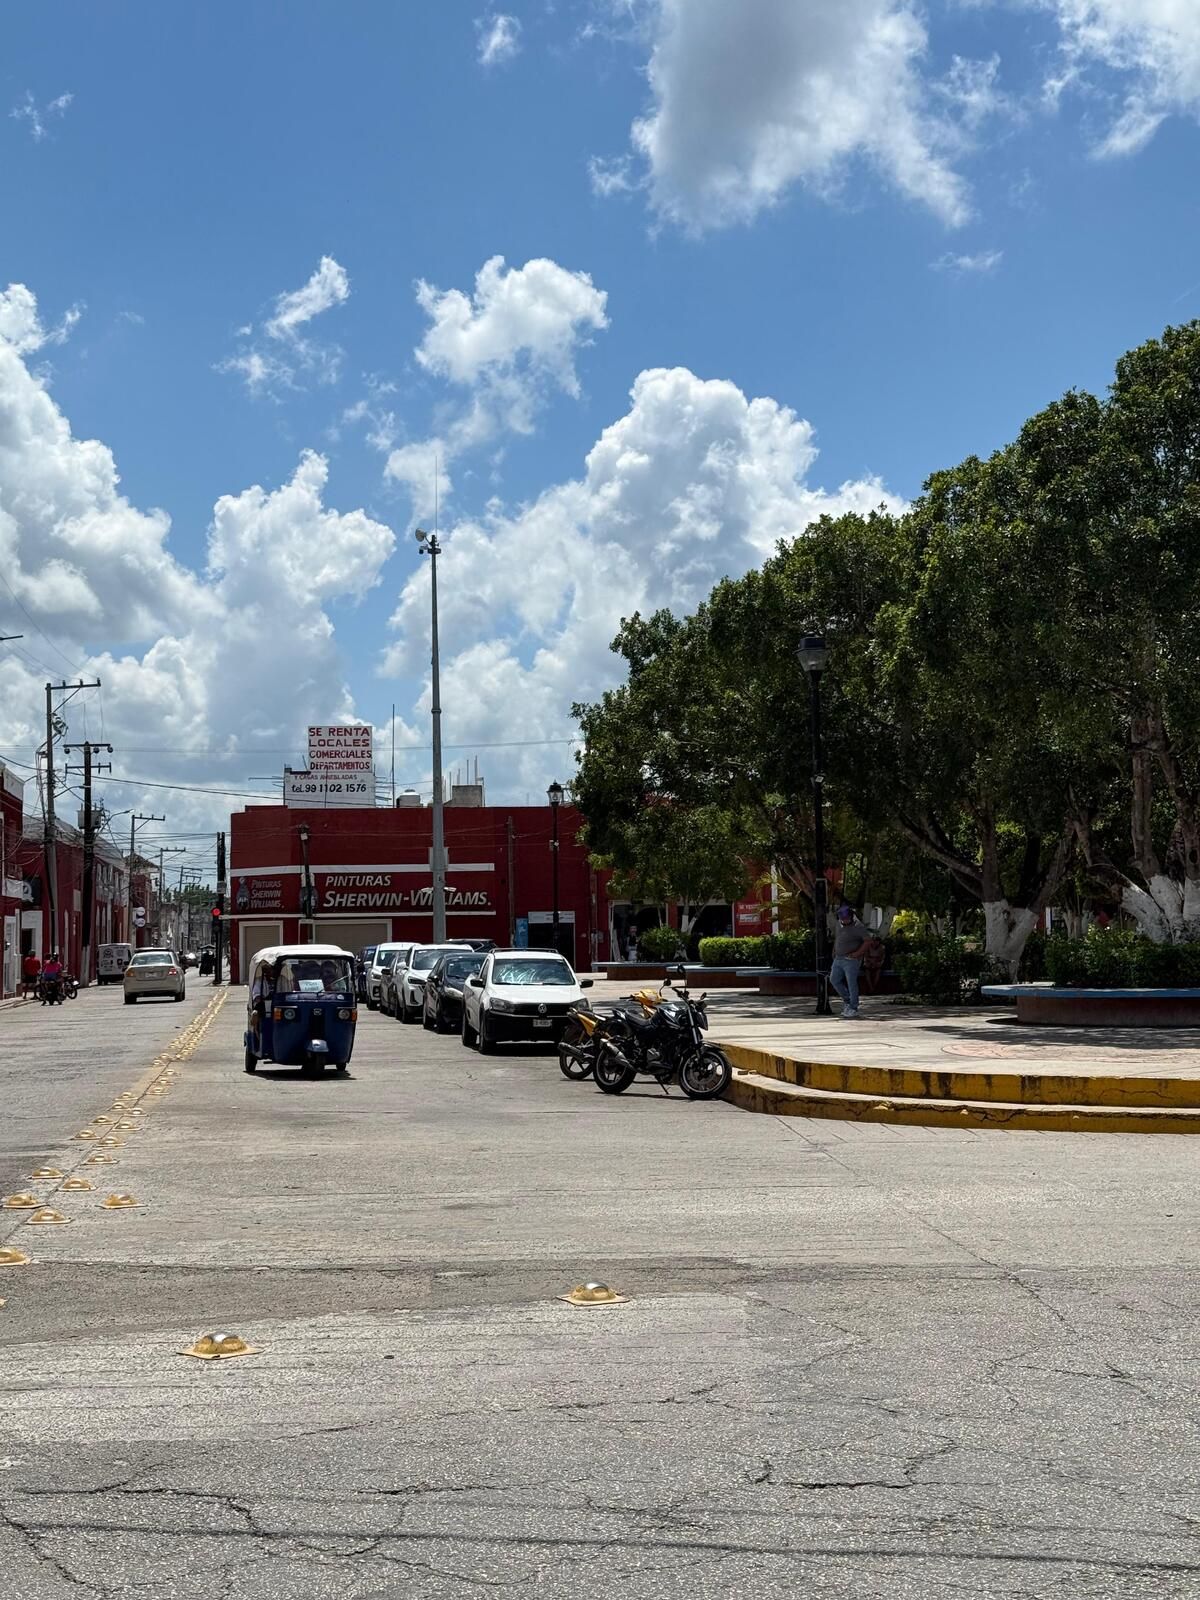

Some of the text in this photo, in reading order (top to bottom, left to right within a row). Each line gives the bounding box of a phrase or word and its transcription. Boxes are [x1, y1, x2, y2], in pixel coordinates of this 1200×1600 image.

[308, 727, 370, 737] SE RENTA
[308, 738, 370, 747] LOCALES
[309, 749, 372, 759] COMERCIALES
[310, 761, 370, 770] DEPARTAMENTOS
[319, 783, 342, 793] 1102
[346, 783, 367, 793] 1576
[251, 880, 282, 888] PINTURAS
[326, 875, 392, 887] PINTURAS
[251, 889, 281, 899] SHERWIN
